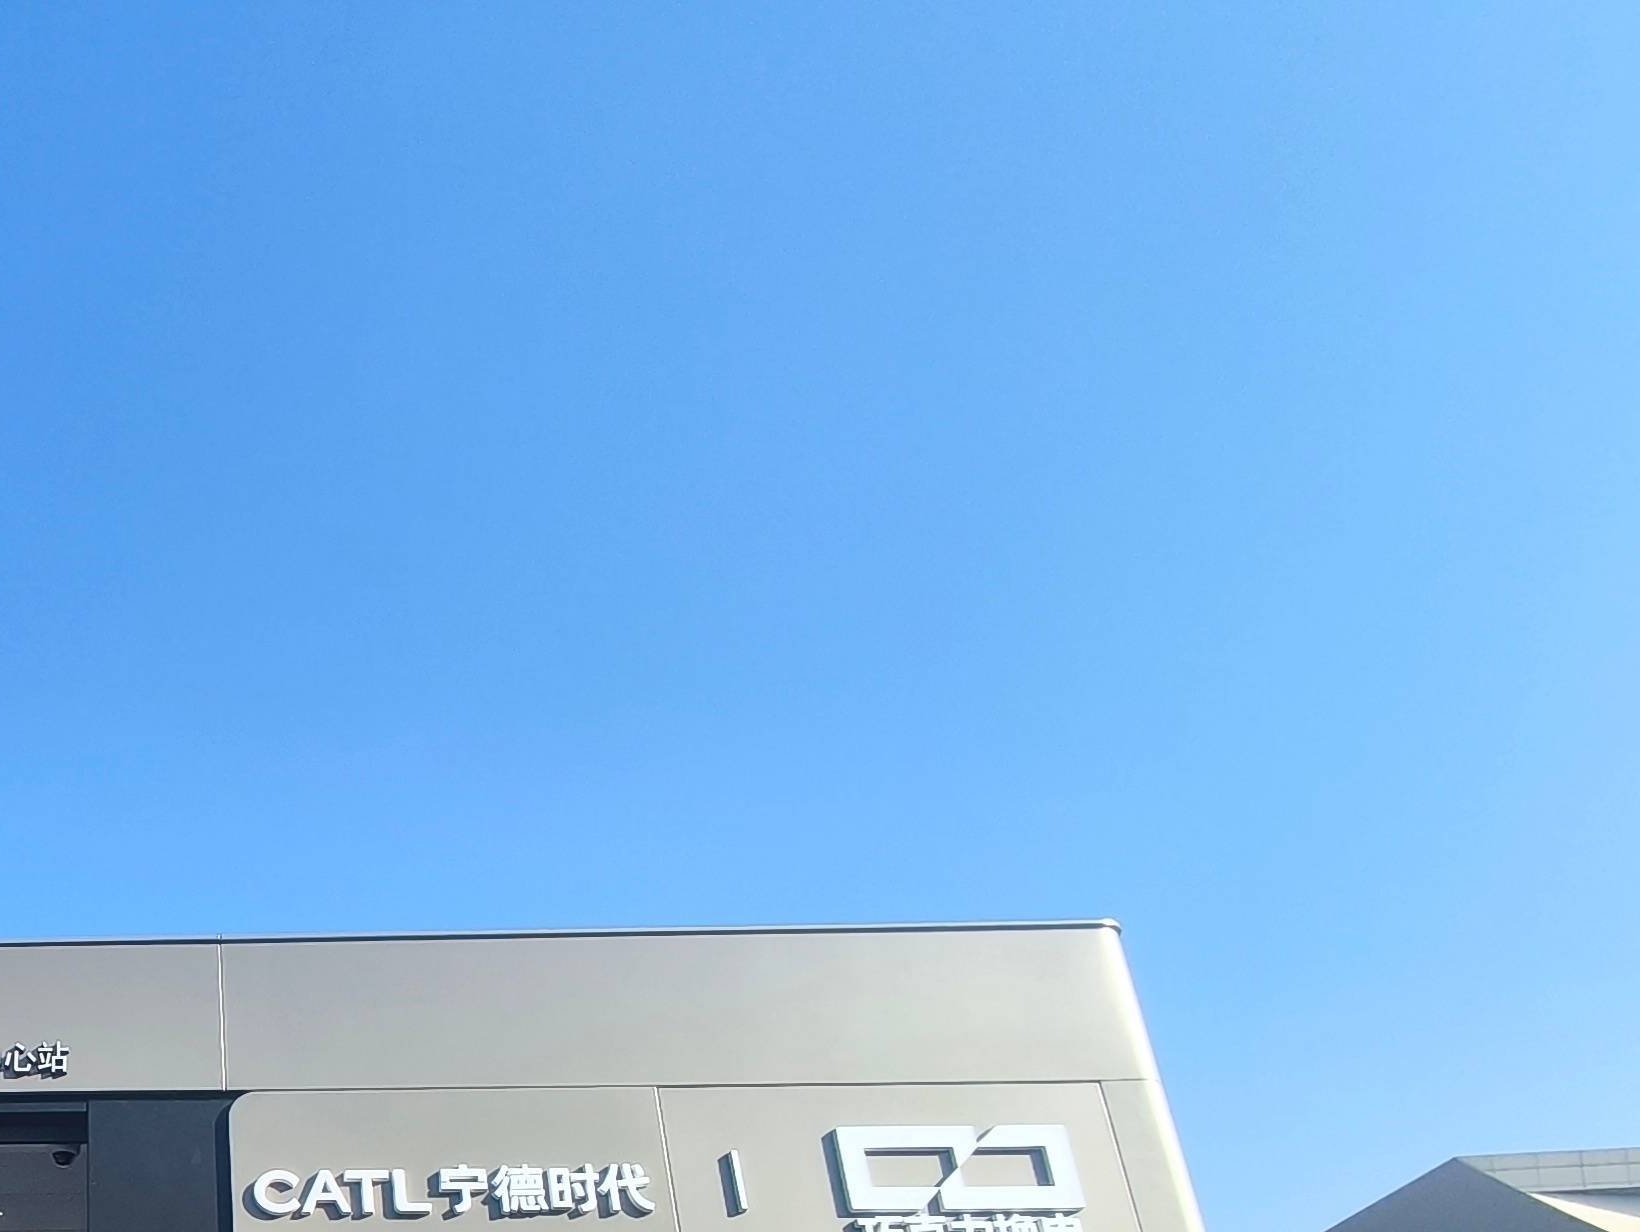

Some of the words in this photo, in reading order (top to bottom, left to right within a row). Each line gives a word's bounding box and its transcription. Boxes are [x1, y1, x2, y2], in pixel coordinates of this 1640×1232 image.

[252, 1167, 434, 1216] CATL
[437, 1162, 656, 1215] 宁德时代
